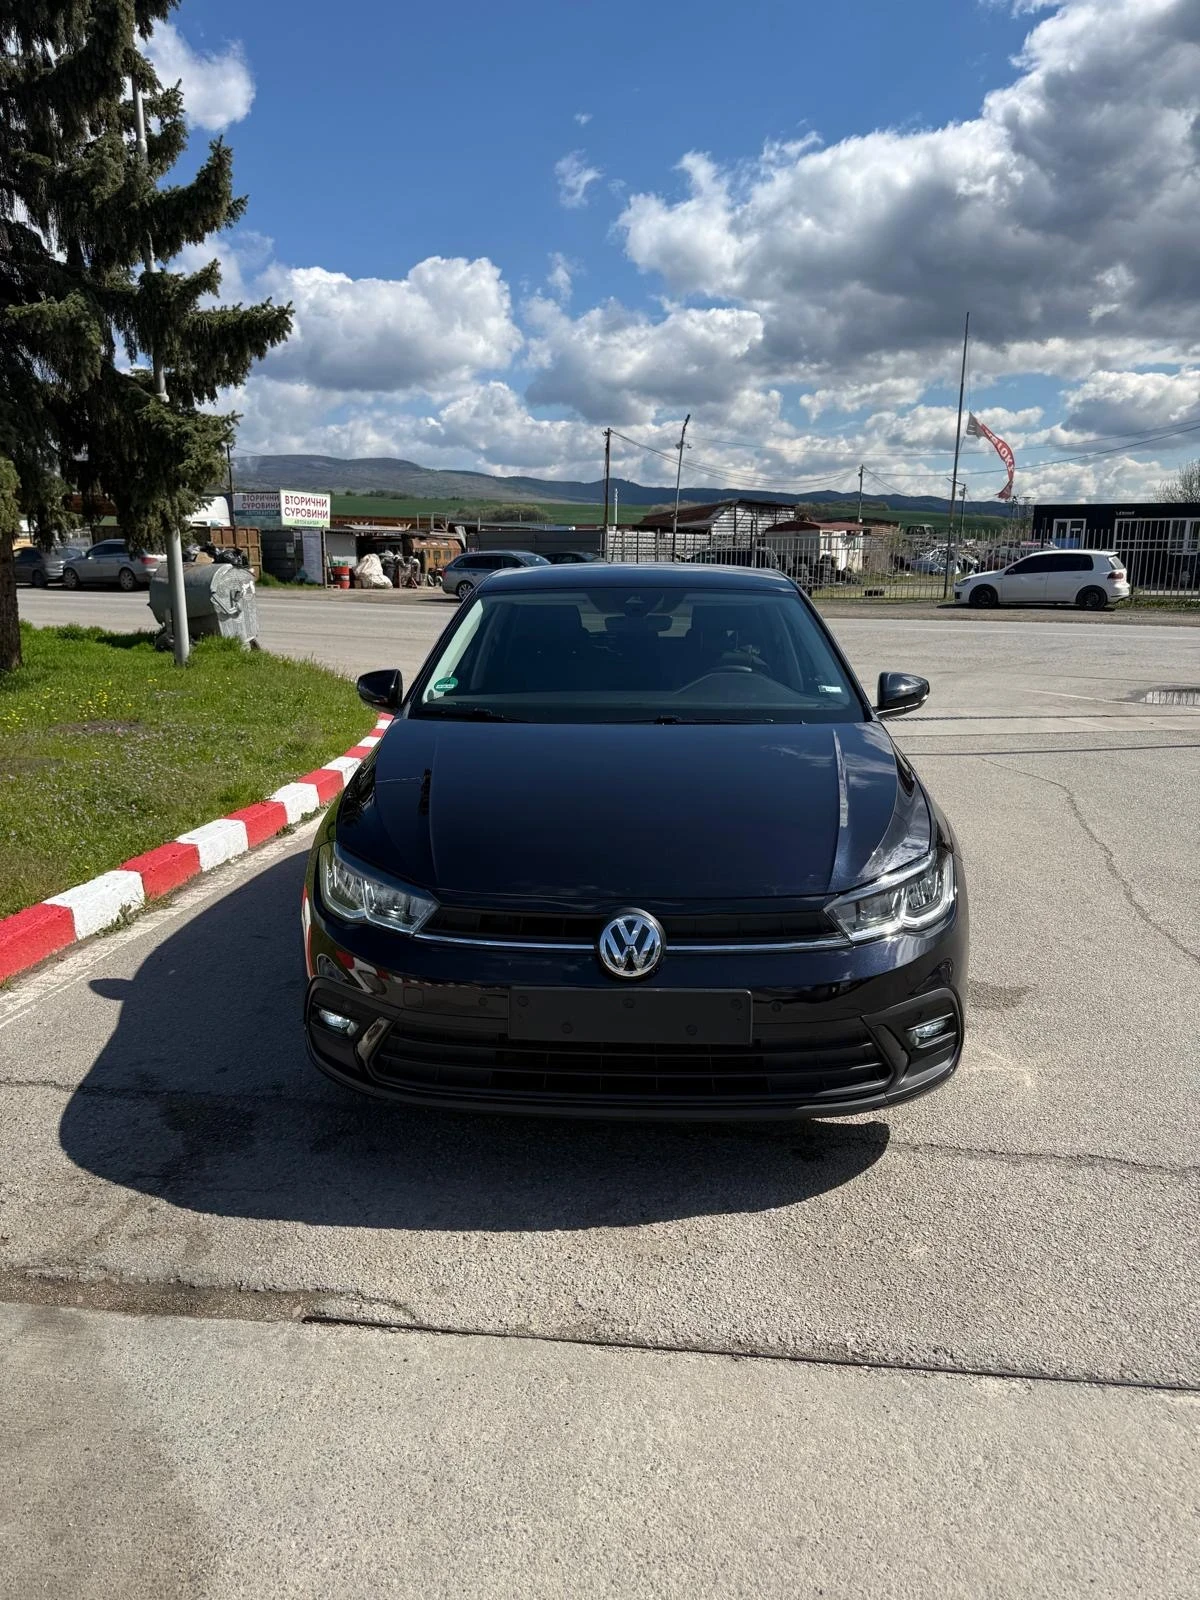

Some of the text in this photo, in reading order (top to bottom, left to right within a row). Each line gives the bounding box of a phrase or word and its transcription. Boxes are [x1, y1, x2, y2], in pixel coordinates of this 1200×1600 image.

[242, 494, 280, 502] ВТОРИЧНИ
[285, 496, 327, 507] ВТОРИЧНИ
[241, 502, 281, 510] СУРОВИНИ
[284, 507, 328, 519] СУРОВИНИ
[600, 915, 661, 976] VW
